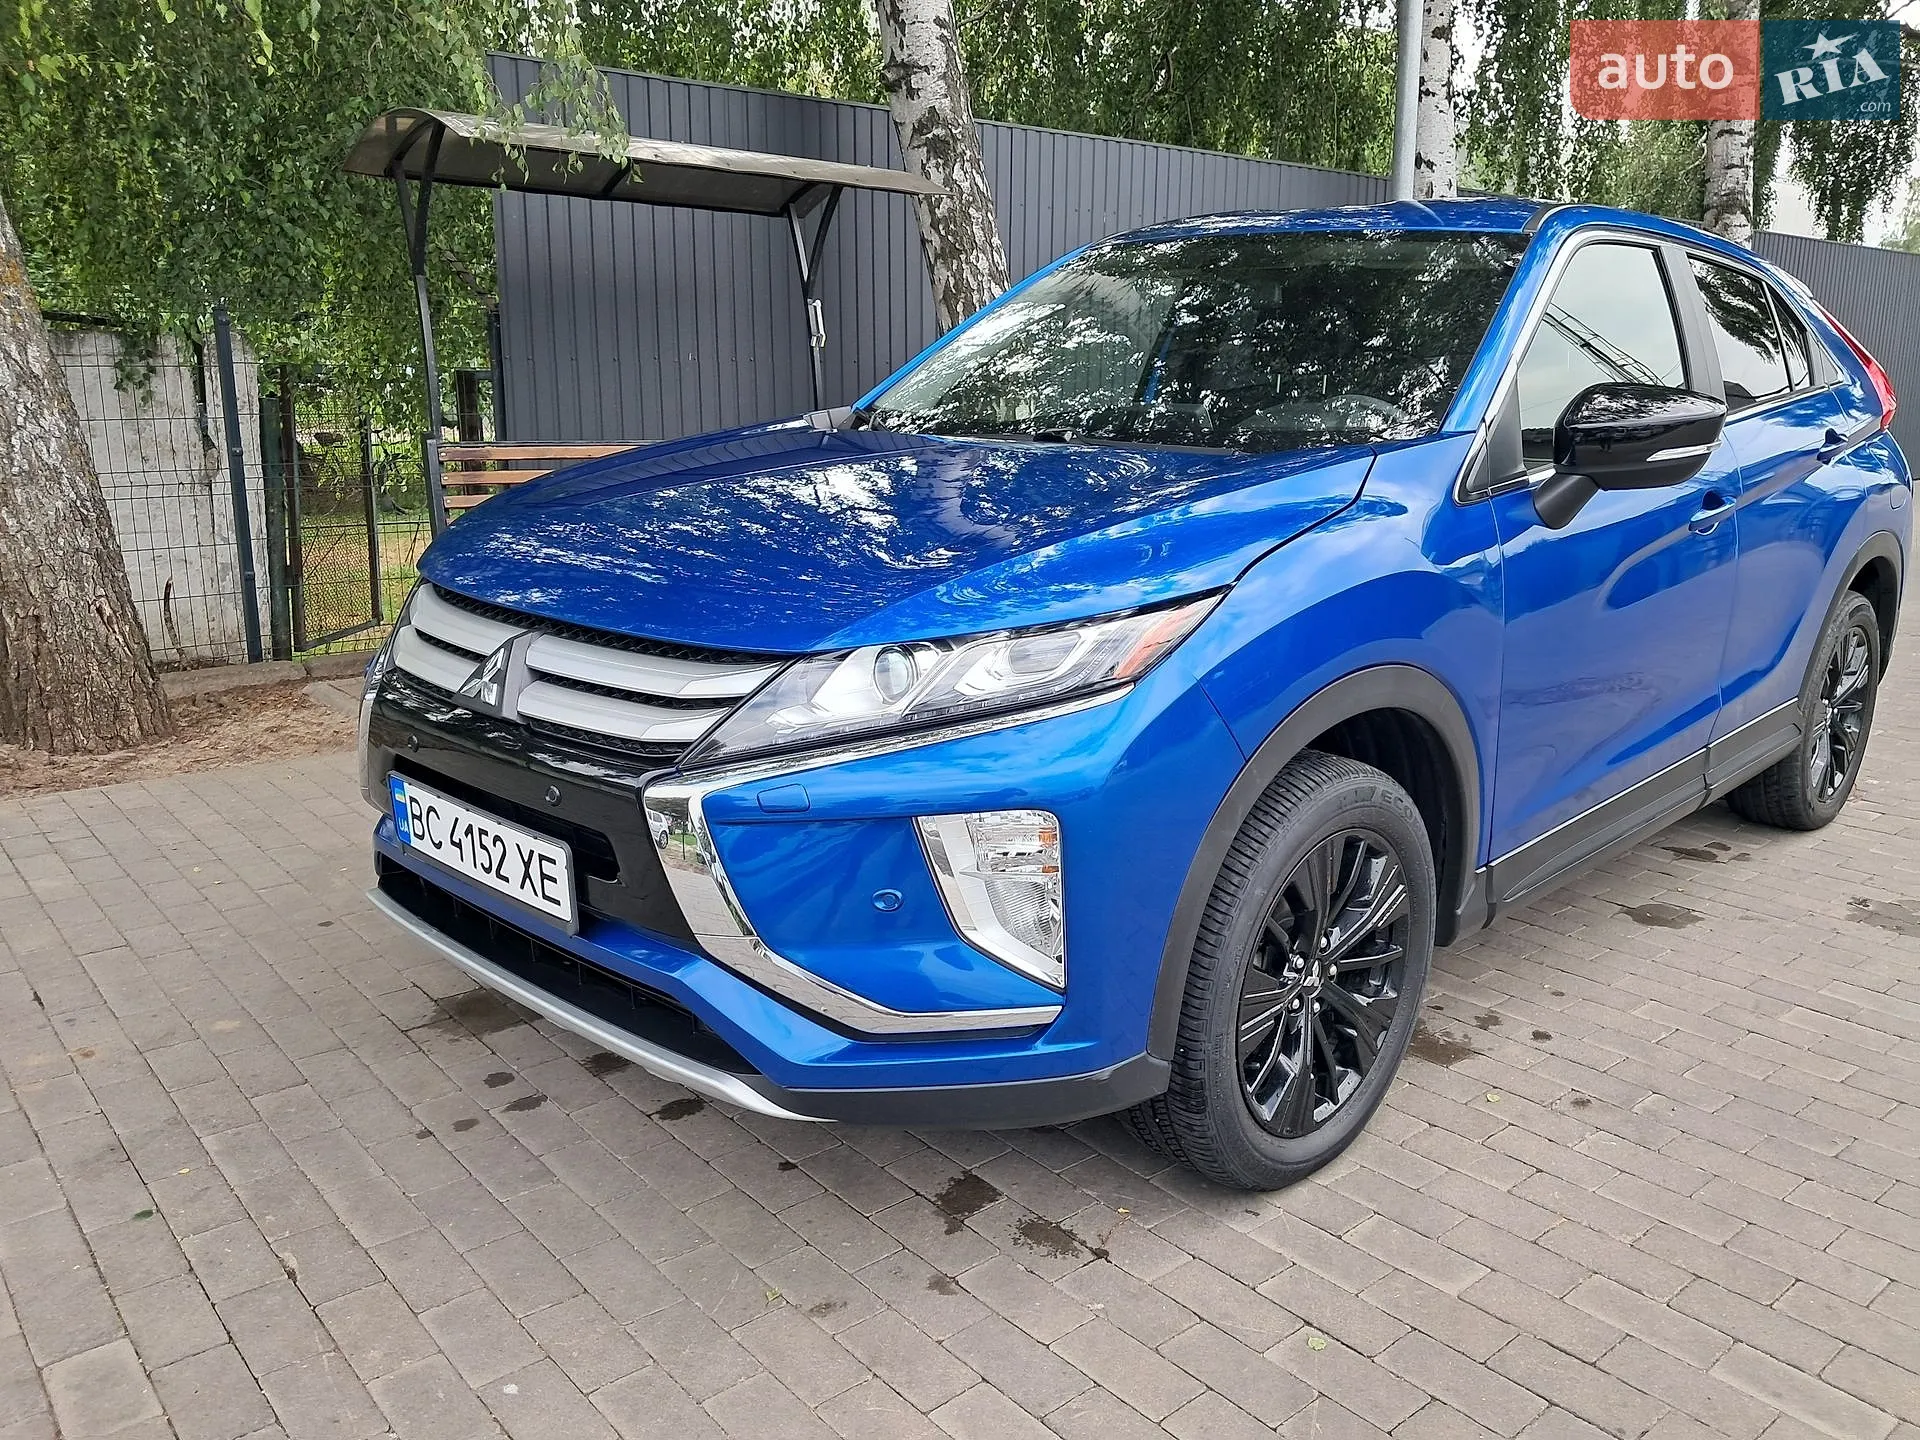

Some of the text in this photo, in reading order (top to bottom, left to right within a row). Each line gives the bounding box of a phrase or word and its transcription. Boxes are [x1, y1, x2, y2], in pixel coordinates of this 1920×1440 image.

[398, 816, 410, 834] UA
[409, 795, 561, 907] BC 4152 XE
